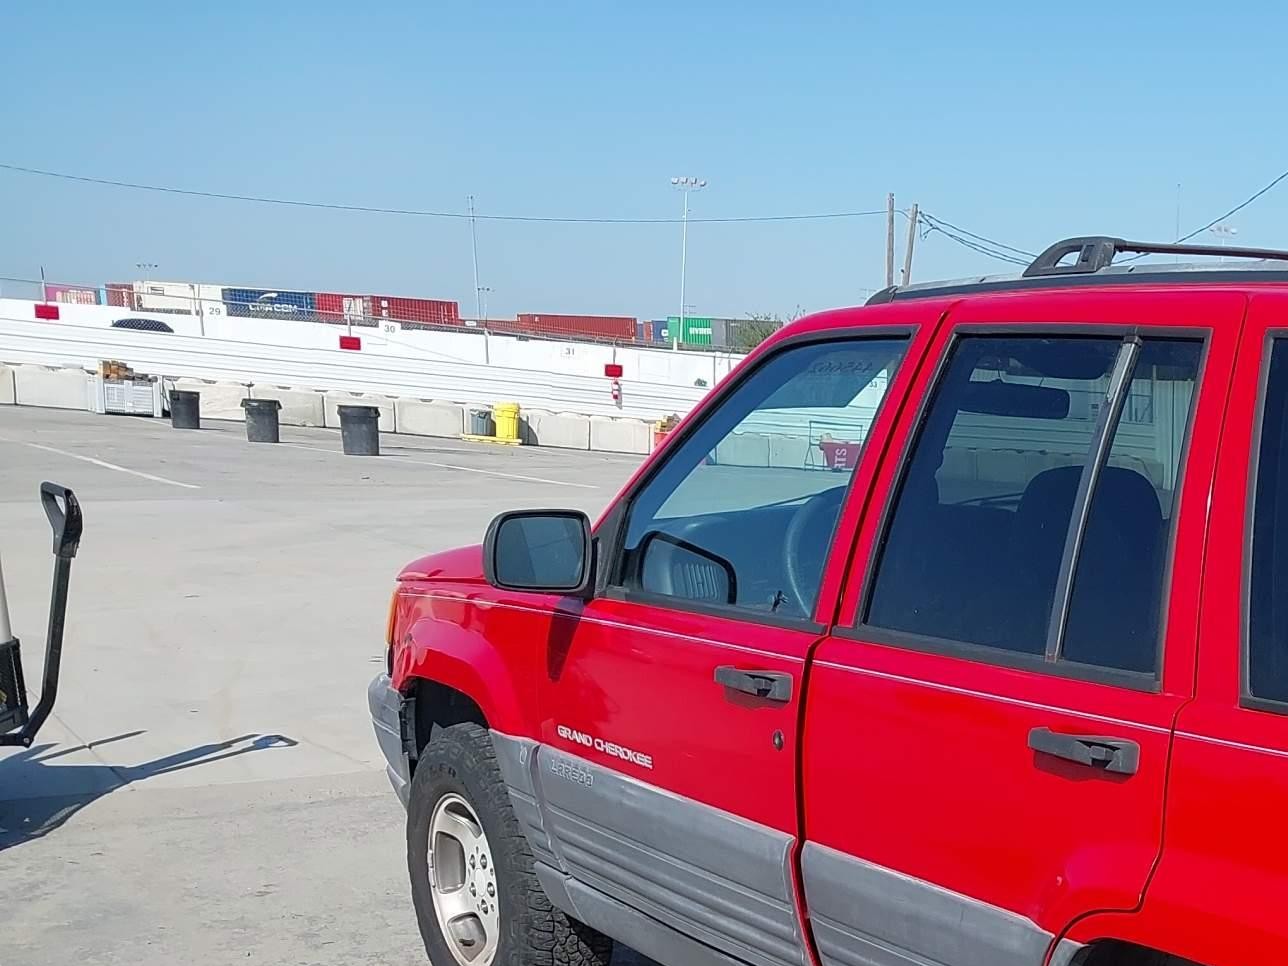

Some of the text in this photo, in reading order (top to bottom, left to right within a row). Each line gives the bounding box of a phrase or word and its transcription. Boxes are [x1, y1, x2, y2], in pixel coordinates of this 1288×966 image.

[209, 307, 221, 315] 29
[384, 324, 396, 333] 30
[557, 725, 653, 770] GRAND CHEROKEE
